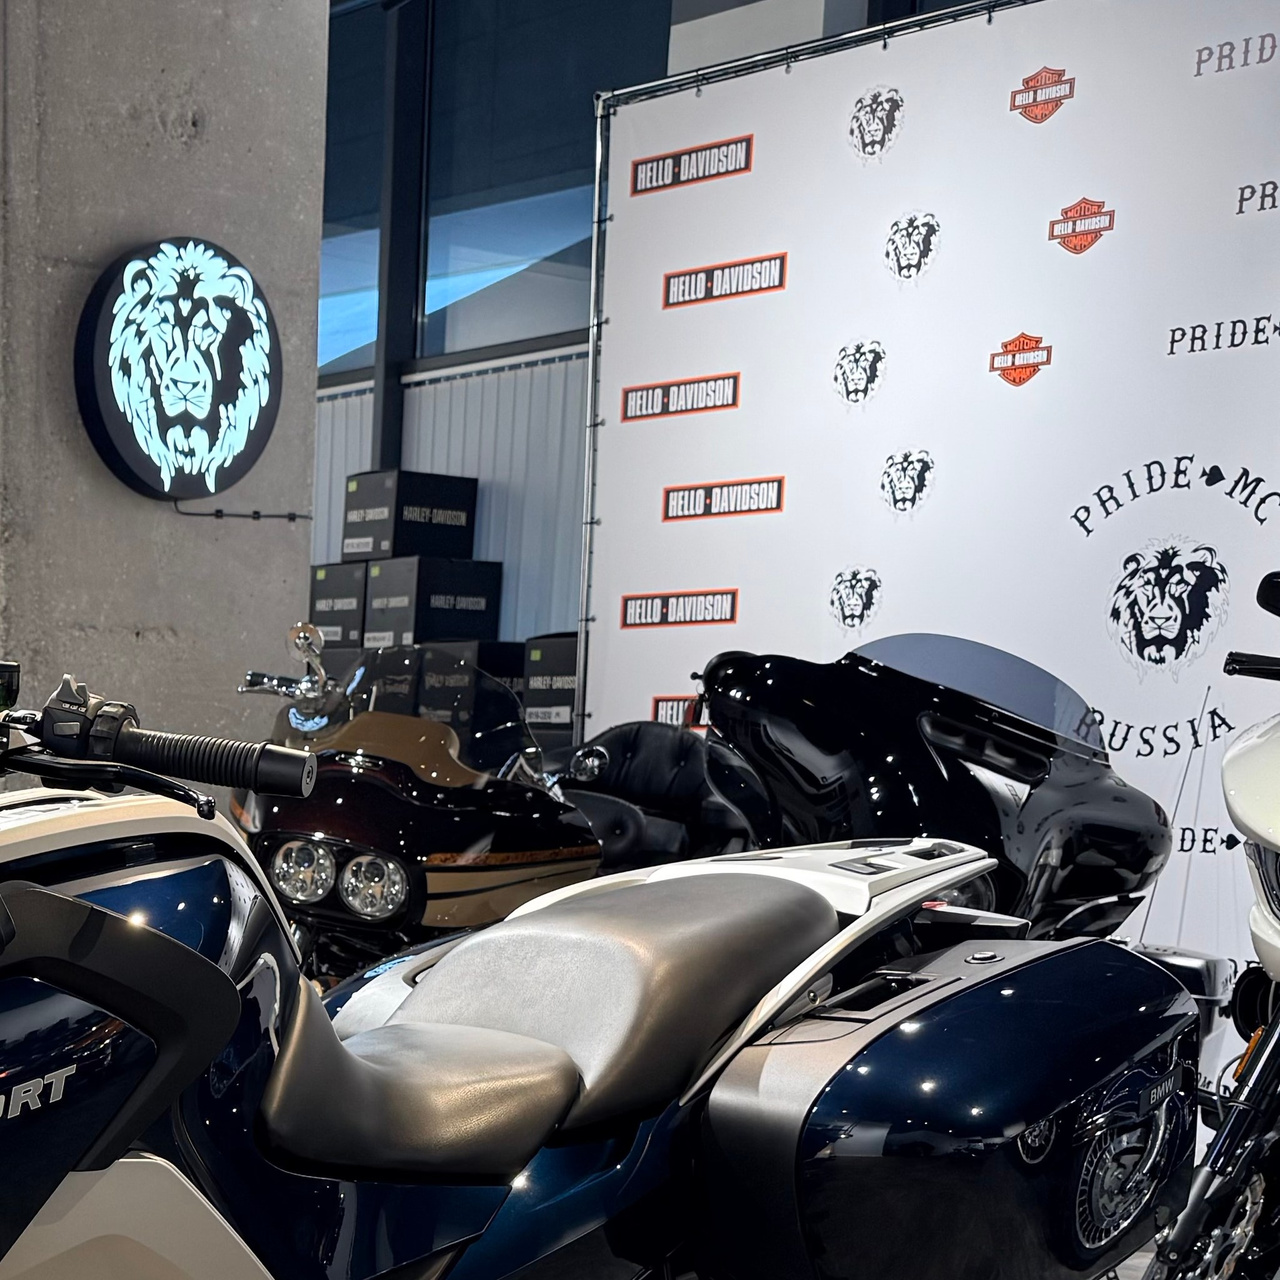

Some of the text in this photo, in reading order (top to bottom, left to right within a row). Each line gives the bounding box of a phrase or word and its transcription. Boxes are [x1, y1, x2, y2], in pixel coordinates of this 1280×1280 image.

[1028, 73, 1059, 88] MOTOR
[637, 142, 747, 190] HELLO DAVIDSON
[1067, 203, 1099, 218] MOTOR
[669, 259, 781, 303] HELLO DAVIDSON
[1006, 338, 1037, 351] MOTOR
[1167, 314, 1272, 356] PRIDE
[627, 378, 734, 417] HELLO DAVIDSON
[668, 482, 779, 517] HELLO DAVIDSON
[1070, 453, 1280, 537] PRIDE MC
[626, 594, 733, 624] HELLO DAVIDSON
[1072, 706, 1236, 758] RUSSIA
[1150, 1076, 1174, 1104] BMW
